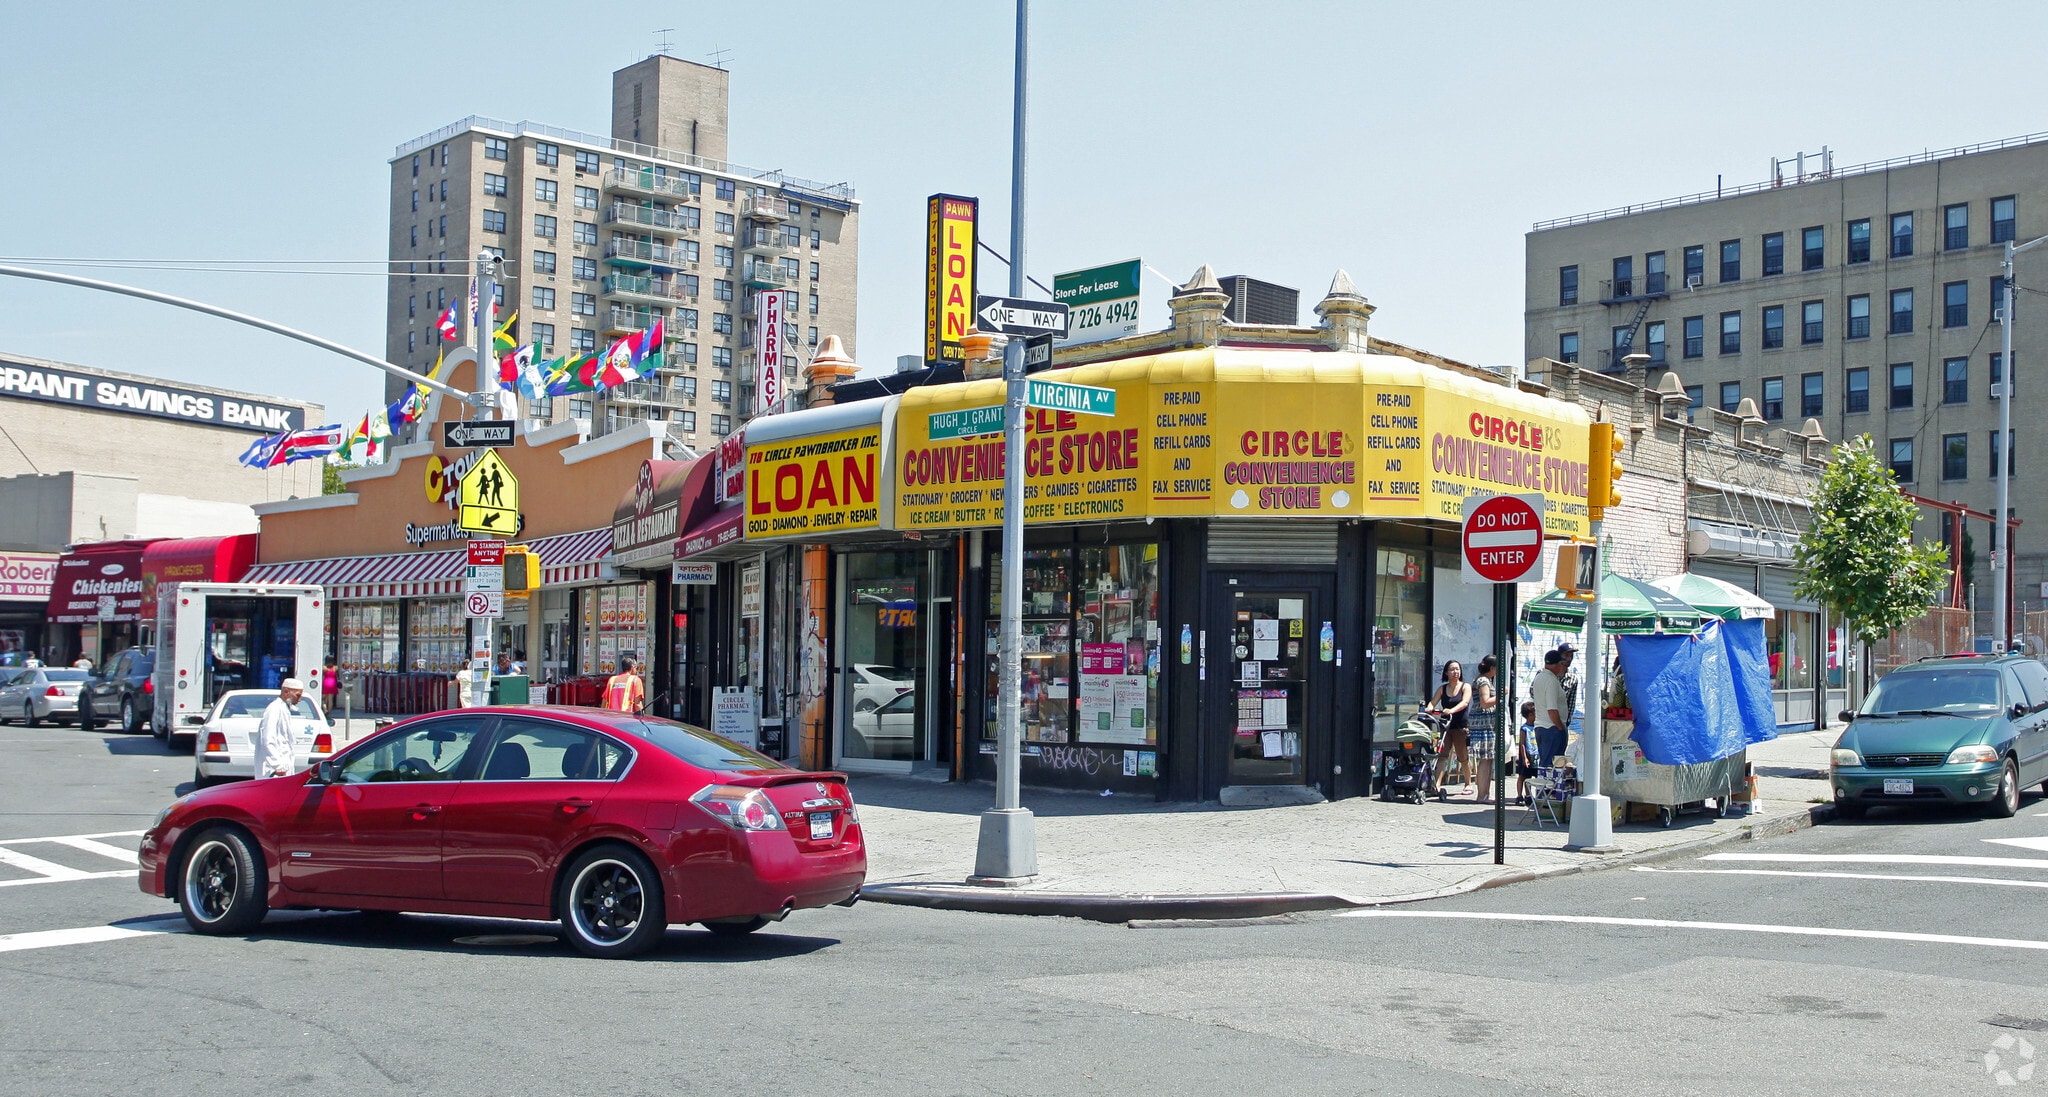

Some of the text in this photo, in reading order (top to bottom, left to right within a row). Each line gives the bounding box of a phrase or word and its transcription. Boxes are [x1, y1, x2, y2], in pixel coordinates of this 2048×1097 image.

[946, 203, 971, 217] PAWN
[947, 226, 966, 337] LOAN
[1055, 280, 1119, 300] Store For Lease
[990, 308, 1058, 328] ONE WAY
[1079, 306, 1101, 329] 226
[1106, 299, 1138, 324] 4942
[764, 295, 777, 407] PHARMACY
[1030, 345, 1046, 361] WAY
[96, 381, 214, 419] SAVINGS
[222, 402, 292, 431] BANK
[1033, 384, 1109, 410] VIRGINIA AV
[1164, 391, 1201, 405] PRE-PAID
[1376, 393, 1411, 408] PRE-PAID
[933, 407, 1003, 430] HUGH J GRANT
[1157, 413, 1207, 428] CELL PHONE
[1370, 415, 1418, 429] CELL PHONE
[455, 428, 506, 440] ONE WAY
[957, 426, 978, 435] CIRCLE
[1469, 412, 1543, 452] CIRCLE
[1154, 434, 1211, 450] REFILL CARDS
[1241, 429, 1343, 457] CIRCLE
[1367, 435, 1421, 450] REFILL CARDS
[764, 447, 793, 462] CIRCLE
[904, 428, 1139, 486] CONVENIECE STORE
[1173, 457, 1191, 471] AND
[1224, 461, 1355, 485] CONVENIENCE
[1385, 458, 1402, 472] AND
[1432, 432, 1588, 498] CONVENIENCE STORE
[751, 453, 875, 515] LOAN
[902, 492, 943, 506] STATIONARY
[950, 489, 983, 504] GROCERY
[1046, 481, 1079, 497] CANDIES
[1087, 477, 1137, 494] CIGARETTES
[1152, 478, 1211, 494] FAX SERVICE
[1368, 480, 1420, 495] FAX SERVICE
[1259, 486, 1321, 509] STORE
[1431, 480, 1465, 497] STATIONARY
[1561, 503, 1588, 517] CIGARETTES
[749, 508, 877, 533] GOLD DIAMOND JEWELRY REPAIR
[910, 511, 922, 524] ICE
[924, 509, 950, 523] CREAM
[955, 507, 986, 522] BUTTER
[1024, 503, 1055, 518] COFFEE
[1064, 498, 1124, 516] ELECTRONICS
[1440, 501, 1451, 515] ICE
[1545, 515, 1579, 532] ELECTRONICS
[1477, 512, 1528, 528] DO NOT
[613, 523, 630, 550] PIZZA
[637, 507, 678, 544] RESTAURANT
[1480, 551, 1525, 566] ENTER
[677, 573, 713, 581] PHARMACY
[17, 585, 51, 594] WOME
